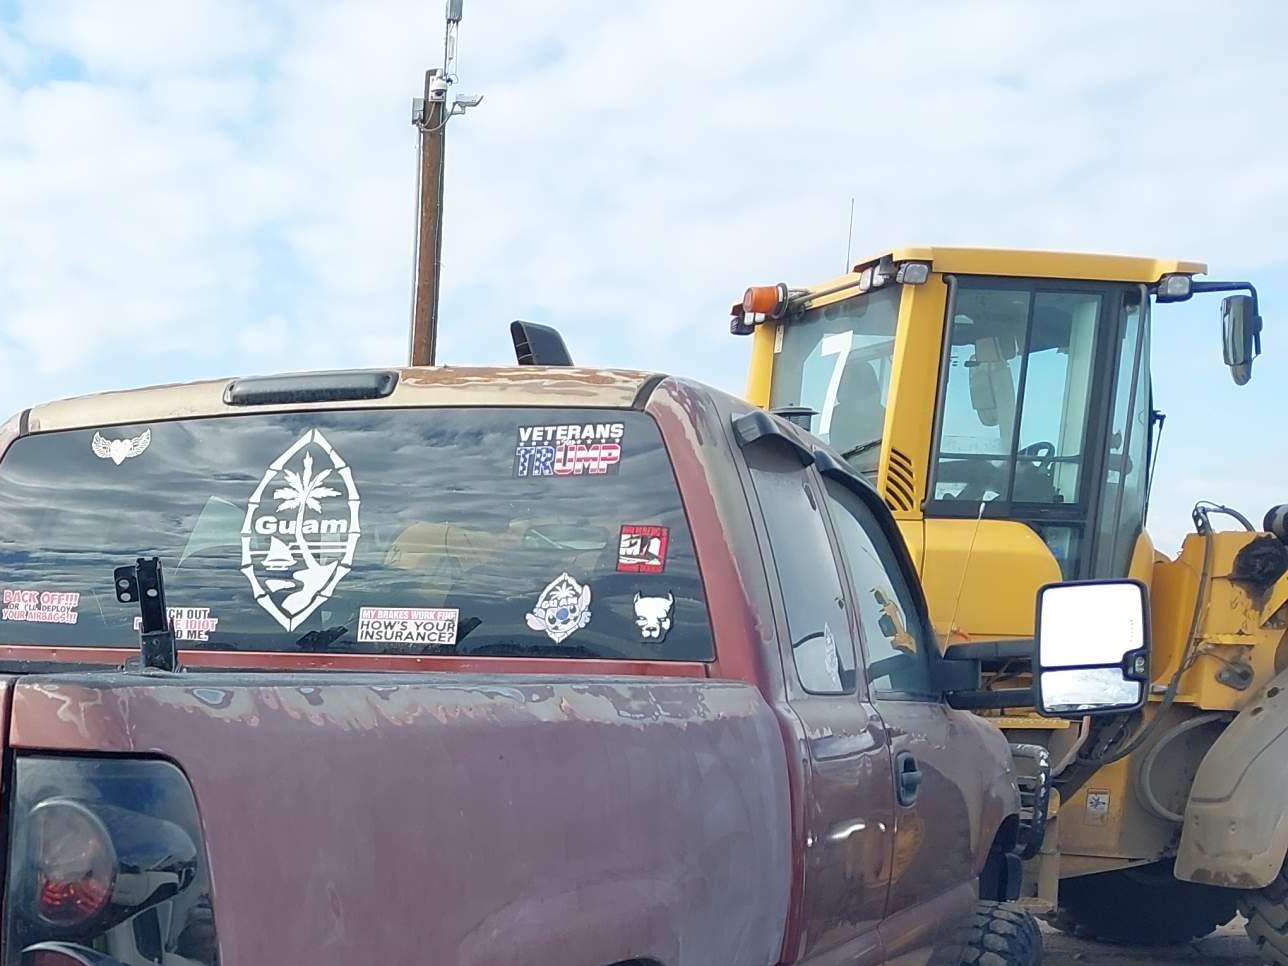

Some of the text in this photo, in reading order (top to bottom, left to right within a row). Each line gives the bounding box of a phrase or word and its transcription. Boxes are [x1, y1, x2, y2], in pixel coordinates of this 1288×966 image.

[821, 330, 853, 434] 7
[518, 423, 625, 442] VETERANS
[515, 443, 622, 477] TRUMP
[254, 515, 348, 535] Guam
[4, 590, 79, 607] BACK OFF!!!
[2, 609, 26, 620] YOUR
[9, 603, 20, 611] OR
[41, 605, 71, 614] DEPLOY
[187, 609, 208, 619] OUT
[363, 609, 376, 619] MY
[377, 609, 409, 620] BRAKES
[411, 610, 434, 620] WORK
[185, 620, 217, 631] IDIOT
[360, 620, 456, 632] HOW'S YOUR
[360, 630, 455, 643] INSURANCE?
